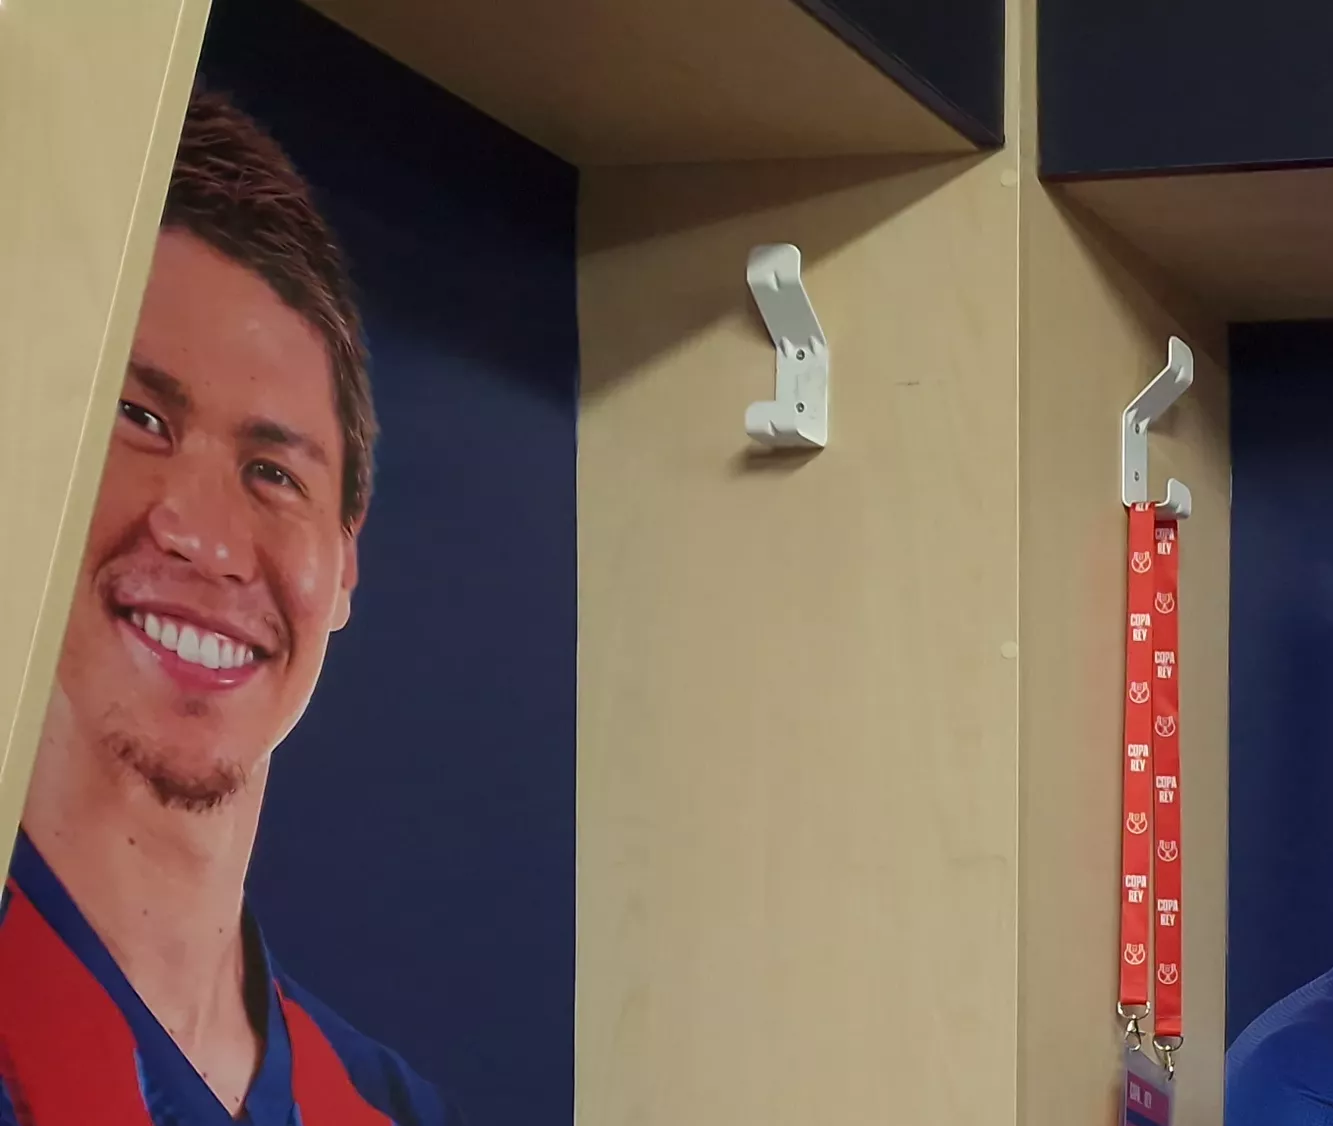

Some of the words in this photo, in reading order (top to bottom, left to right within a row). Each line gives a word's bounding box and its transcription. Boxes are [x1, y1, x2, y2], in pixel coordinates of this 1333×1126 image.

[1131, 613, 1151, 627] COPA
[1133, 628, 1148, 642] REY
[1155, 651, 1175, 664] COPA
[1157, 665, 1172, 679] REY
[1128, 744, 1149, 757] COPA
[1130, 759, 1145, 772] REY
[1156, 776, 1177, 789] COPA
[1158, 790, 1174, 803] REY
[1125, 875, 1147, 888] COPA
[1128, 889, 1144, 903] REY
[1157, 899, 1178, 912] COPA
[1160, 914, 1176, 926] REY
